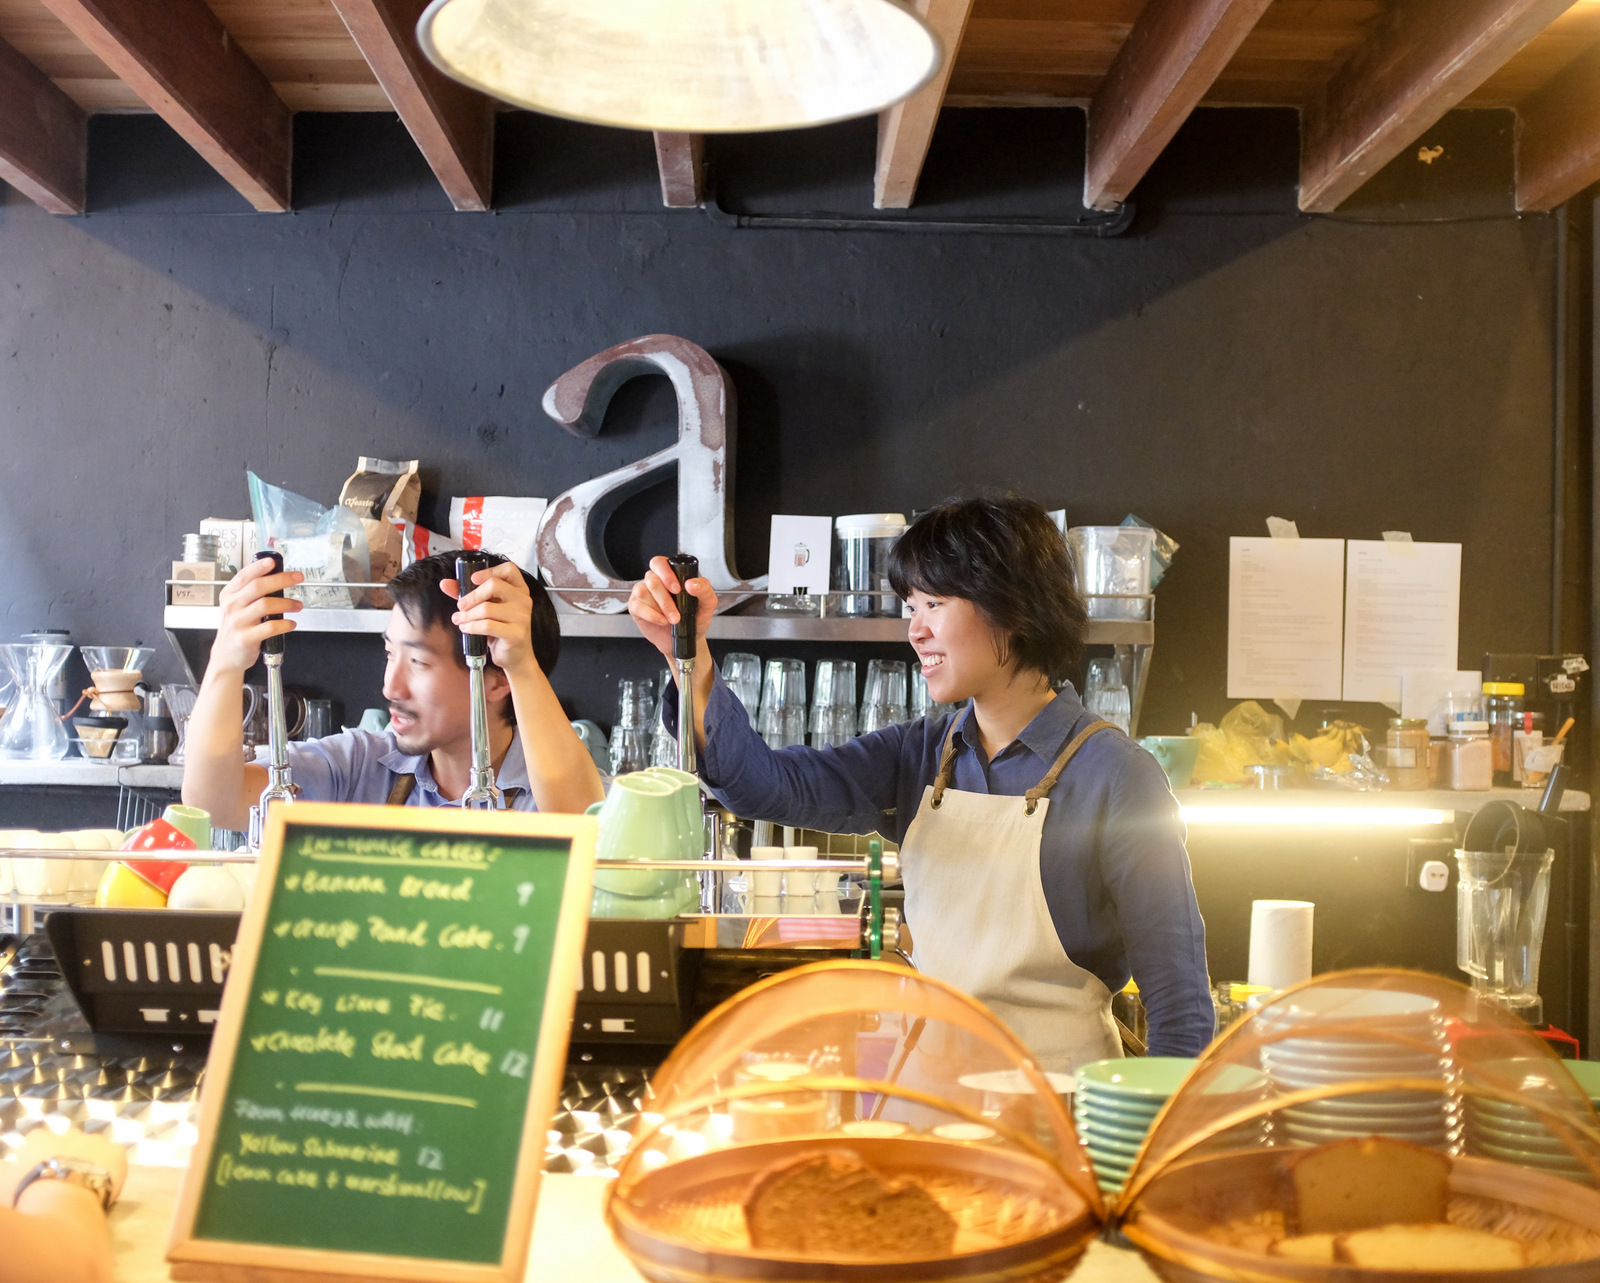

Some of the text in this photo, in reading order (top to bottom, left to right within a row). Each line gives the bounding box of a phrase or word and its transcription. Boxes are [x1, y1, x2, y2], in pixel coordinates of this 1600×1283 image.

[176, 590, 191, 598] VST
[399, 875, 474, 901] Bread
[516, 881, 535, 907] 9
[512, 924, 531, 954] 9
[479, 1006, 505, 1032] 11
[432, 1042, 493, 1075] Cake
[500, 1049, 529, 1078] 12
[417, 1146, 443, 1171] 12
